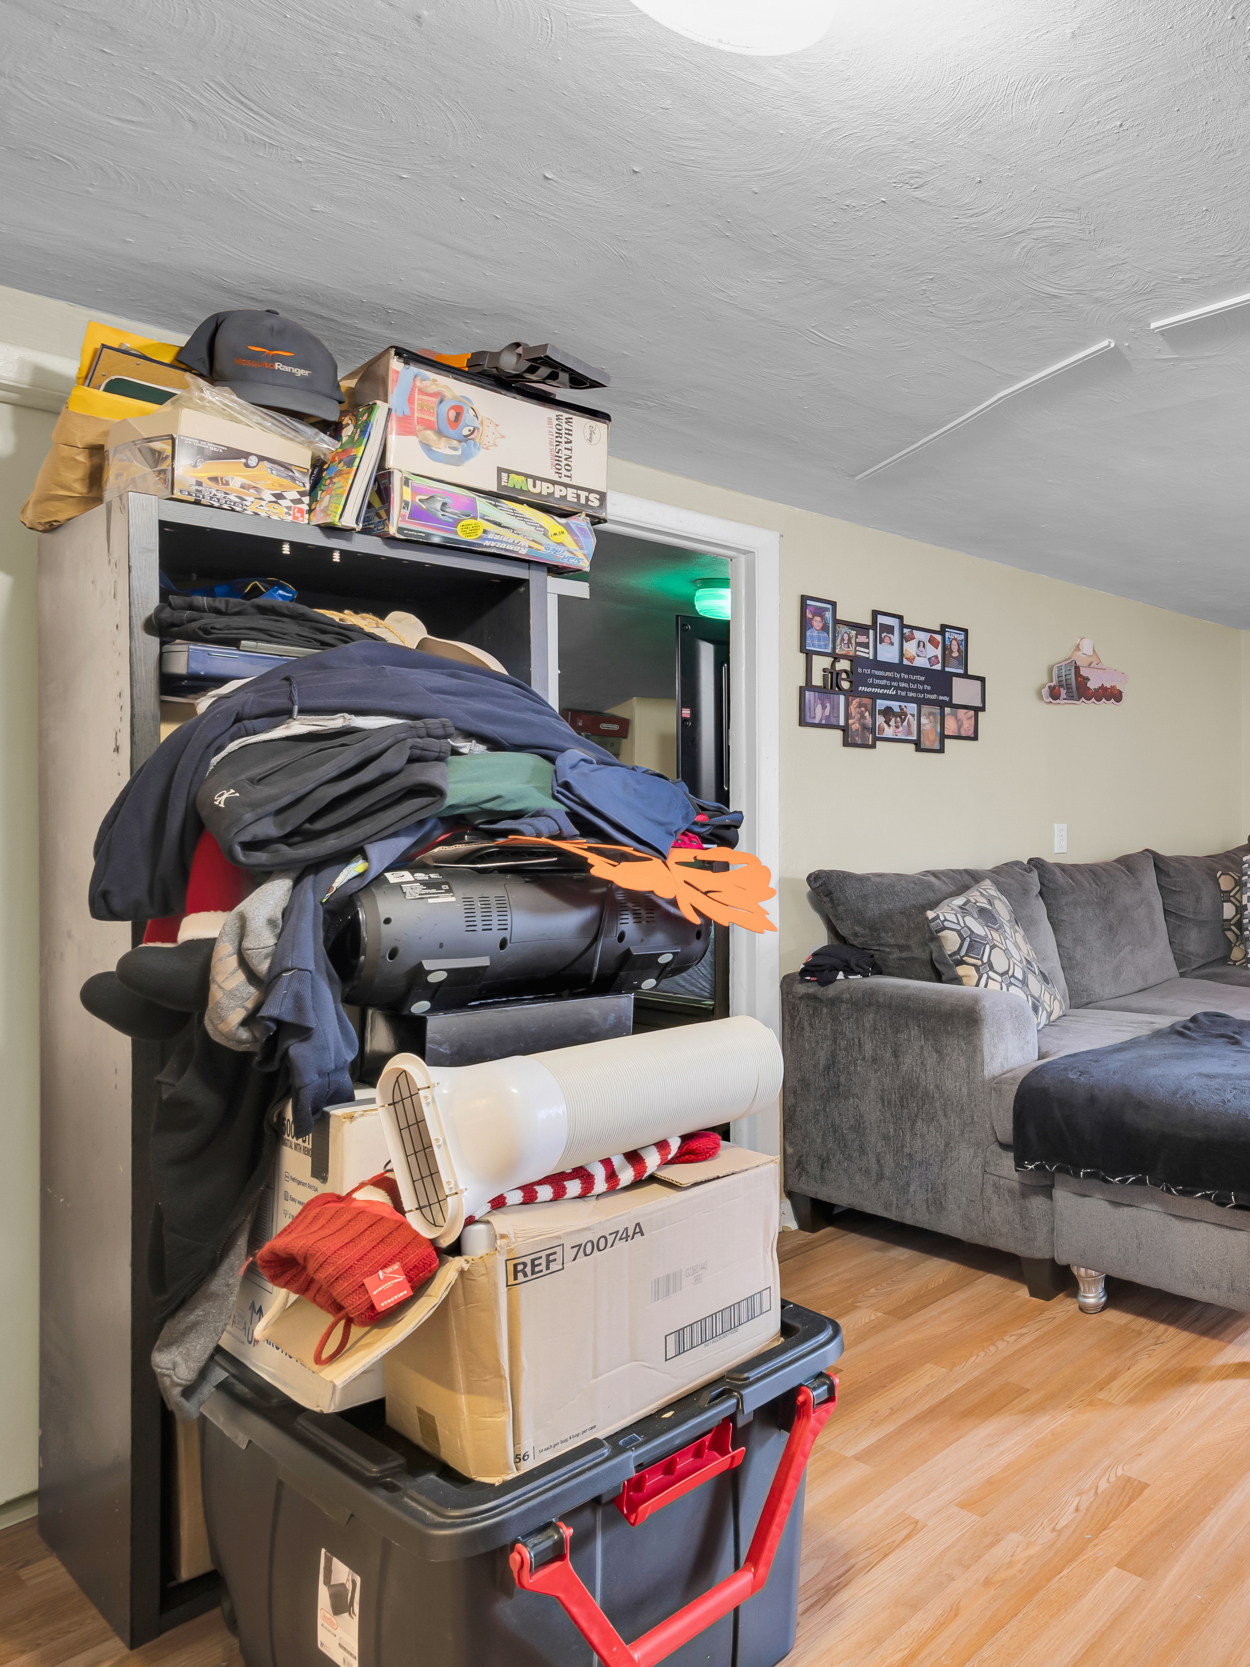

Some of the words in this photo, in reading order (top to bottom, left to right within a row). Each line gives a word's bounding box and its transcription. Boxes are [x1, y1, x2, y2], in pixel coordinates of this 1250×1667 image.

[554, 414, 563, 479] WORKSHOP
[564, 417, 573, 481] WHATNOT
[507, 473, 600, 507] MUPPETS
[858, 686, 897, 695] moments
[513, 1251, 558, 1281] REF
[570, 1222, 645, 1262] 70074A
[514, 1451, 530, 1464] 56
